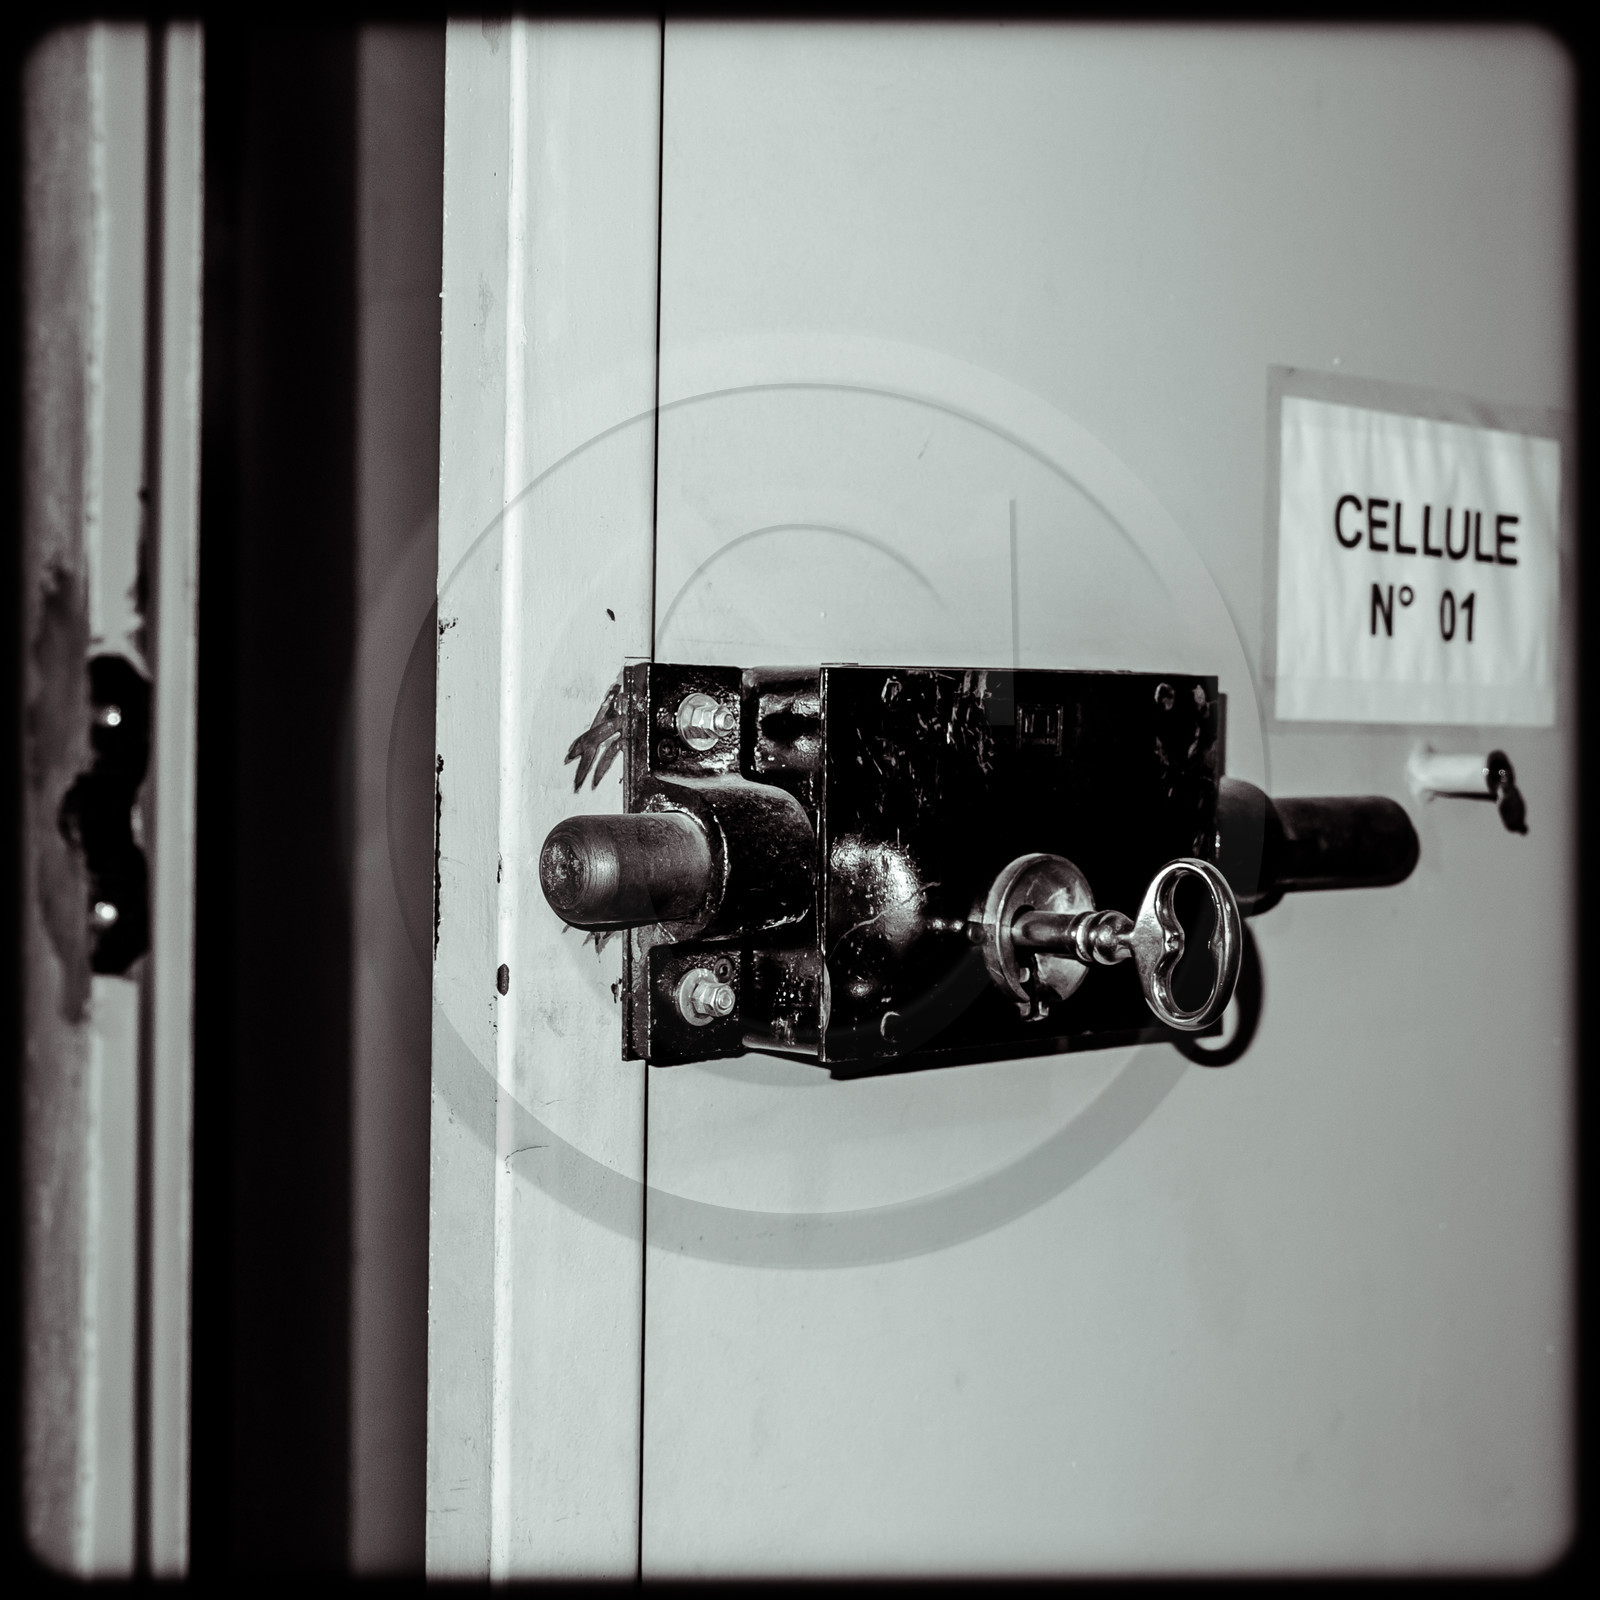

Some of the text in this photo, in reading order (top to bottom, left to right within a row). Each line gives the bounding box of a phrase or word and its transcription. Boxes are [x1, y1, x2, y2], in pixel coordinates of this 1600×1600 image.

[1333, 493, 1520, 566] CELLULE
[1370, 582, 1476, 643] N° 01
